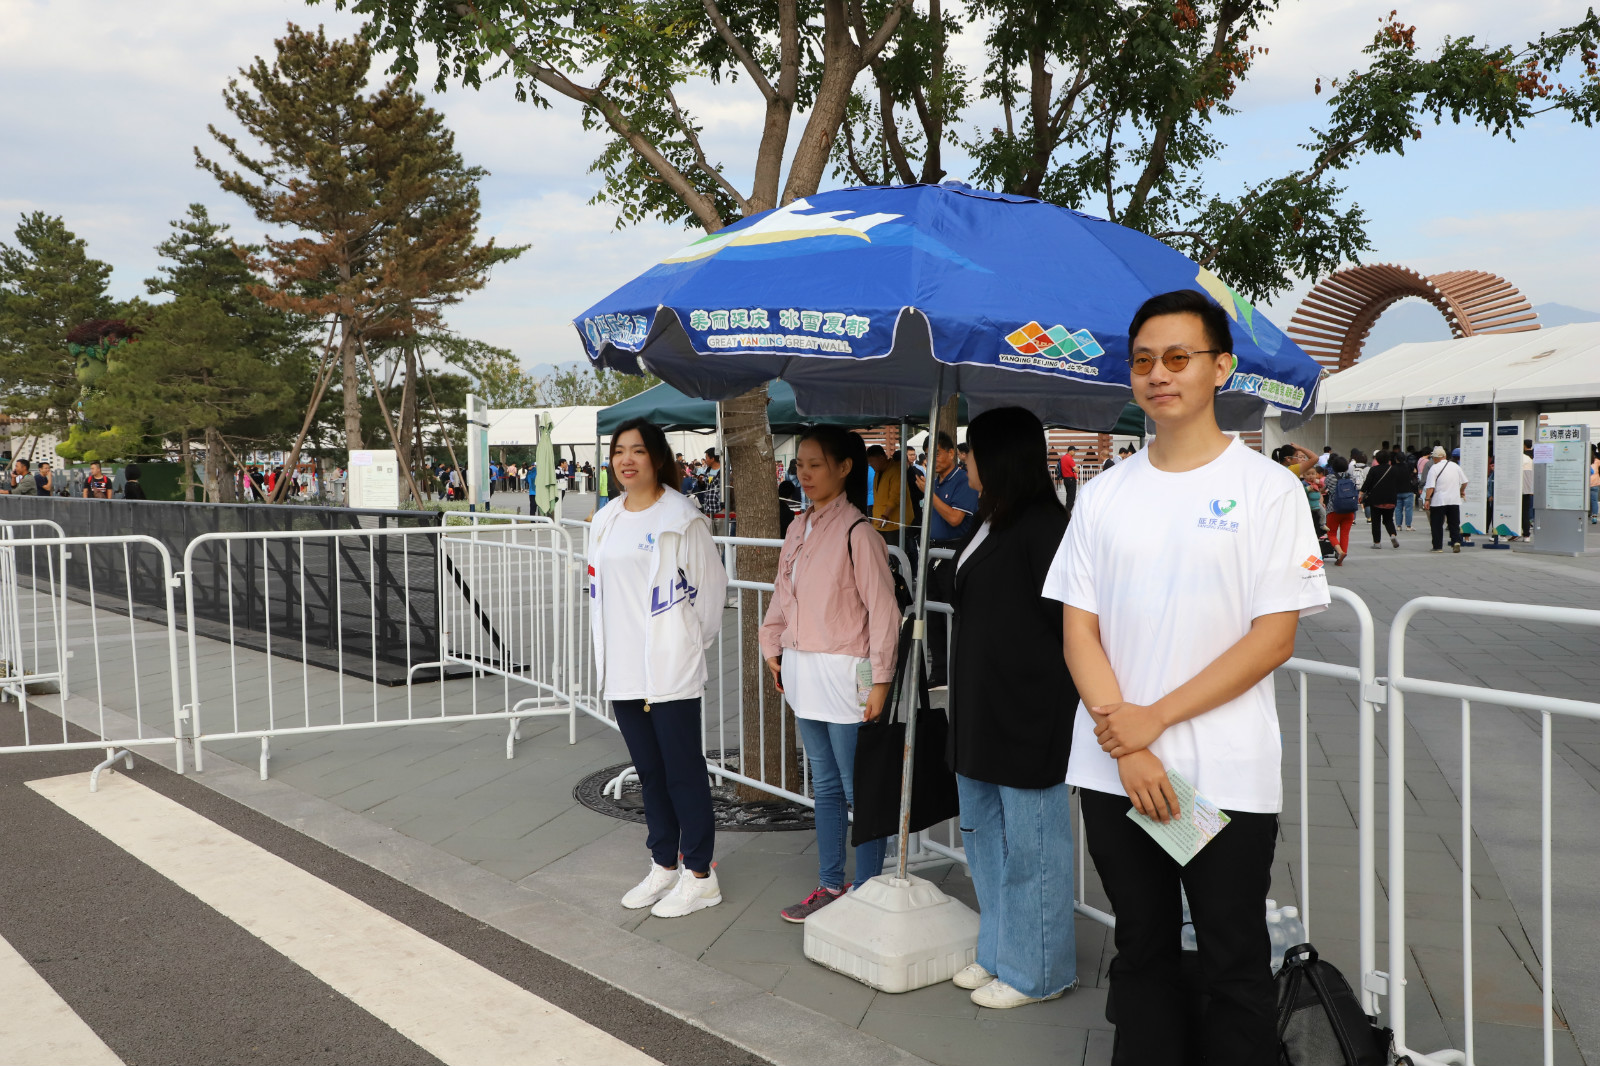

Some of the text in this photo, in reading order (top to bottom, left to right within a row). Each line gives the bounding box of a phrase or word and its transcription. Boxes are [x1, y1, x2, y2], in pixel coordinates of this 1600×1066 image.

[690, 308, 870, 337] 美丽延庆 冰雪夏都
[708, 336, 851, 352] GREAT YANQING GREAT WALL
[1000, 355, 1032, 363] YANQING
[1033, 358, 1058, 367] BEIJING
[1549, 429, 1580, 440] 购票咨询
